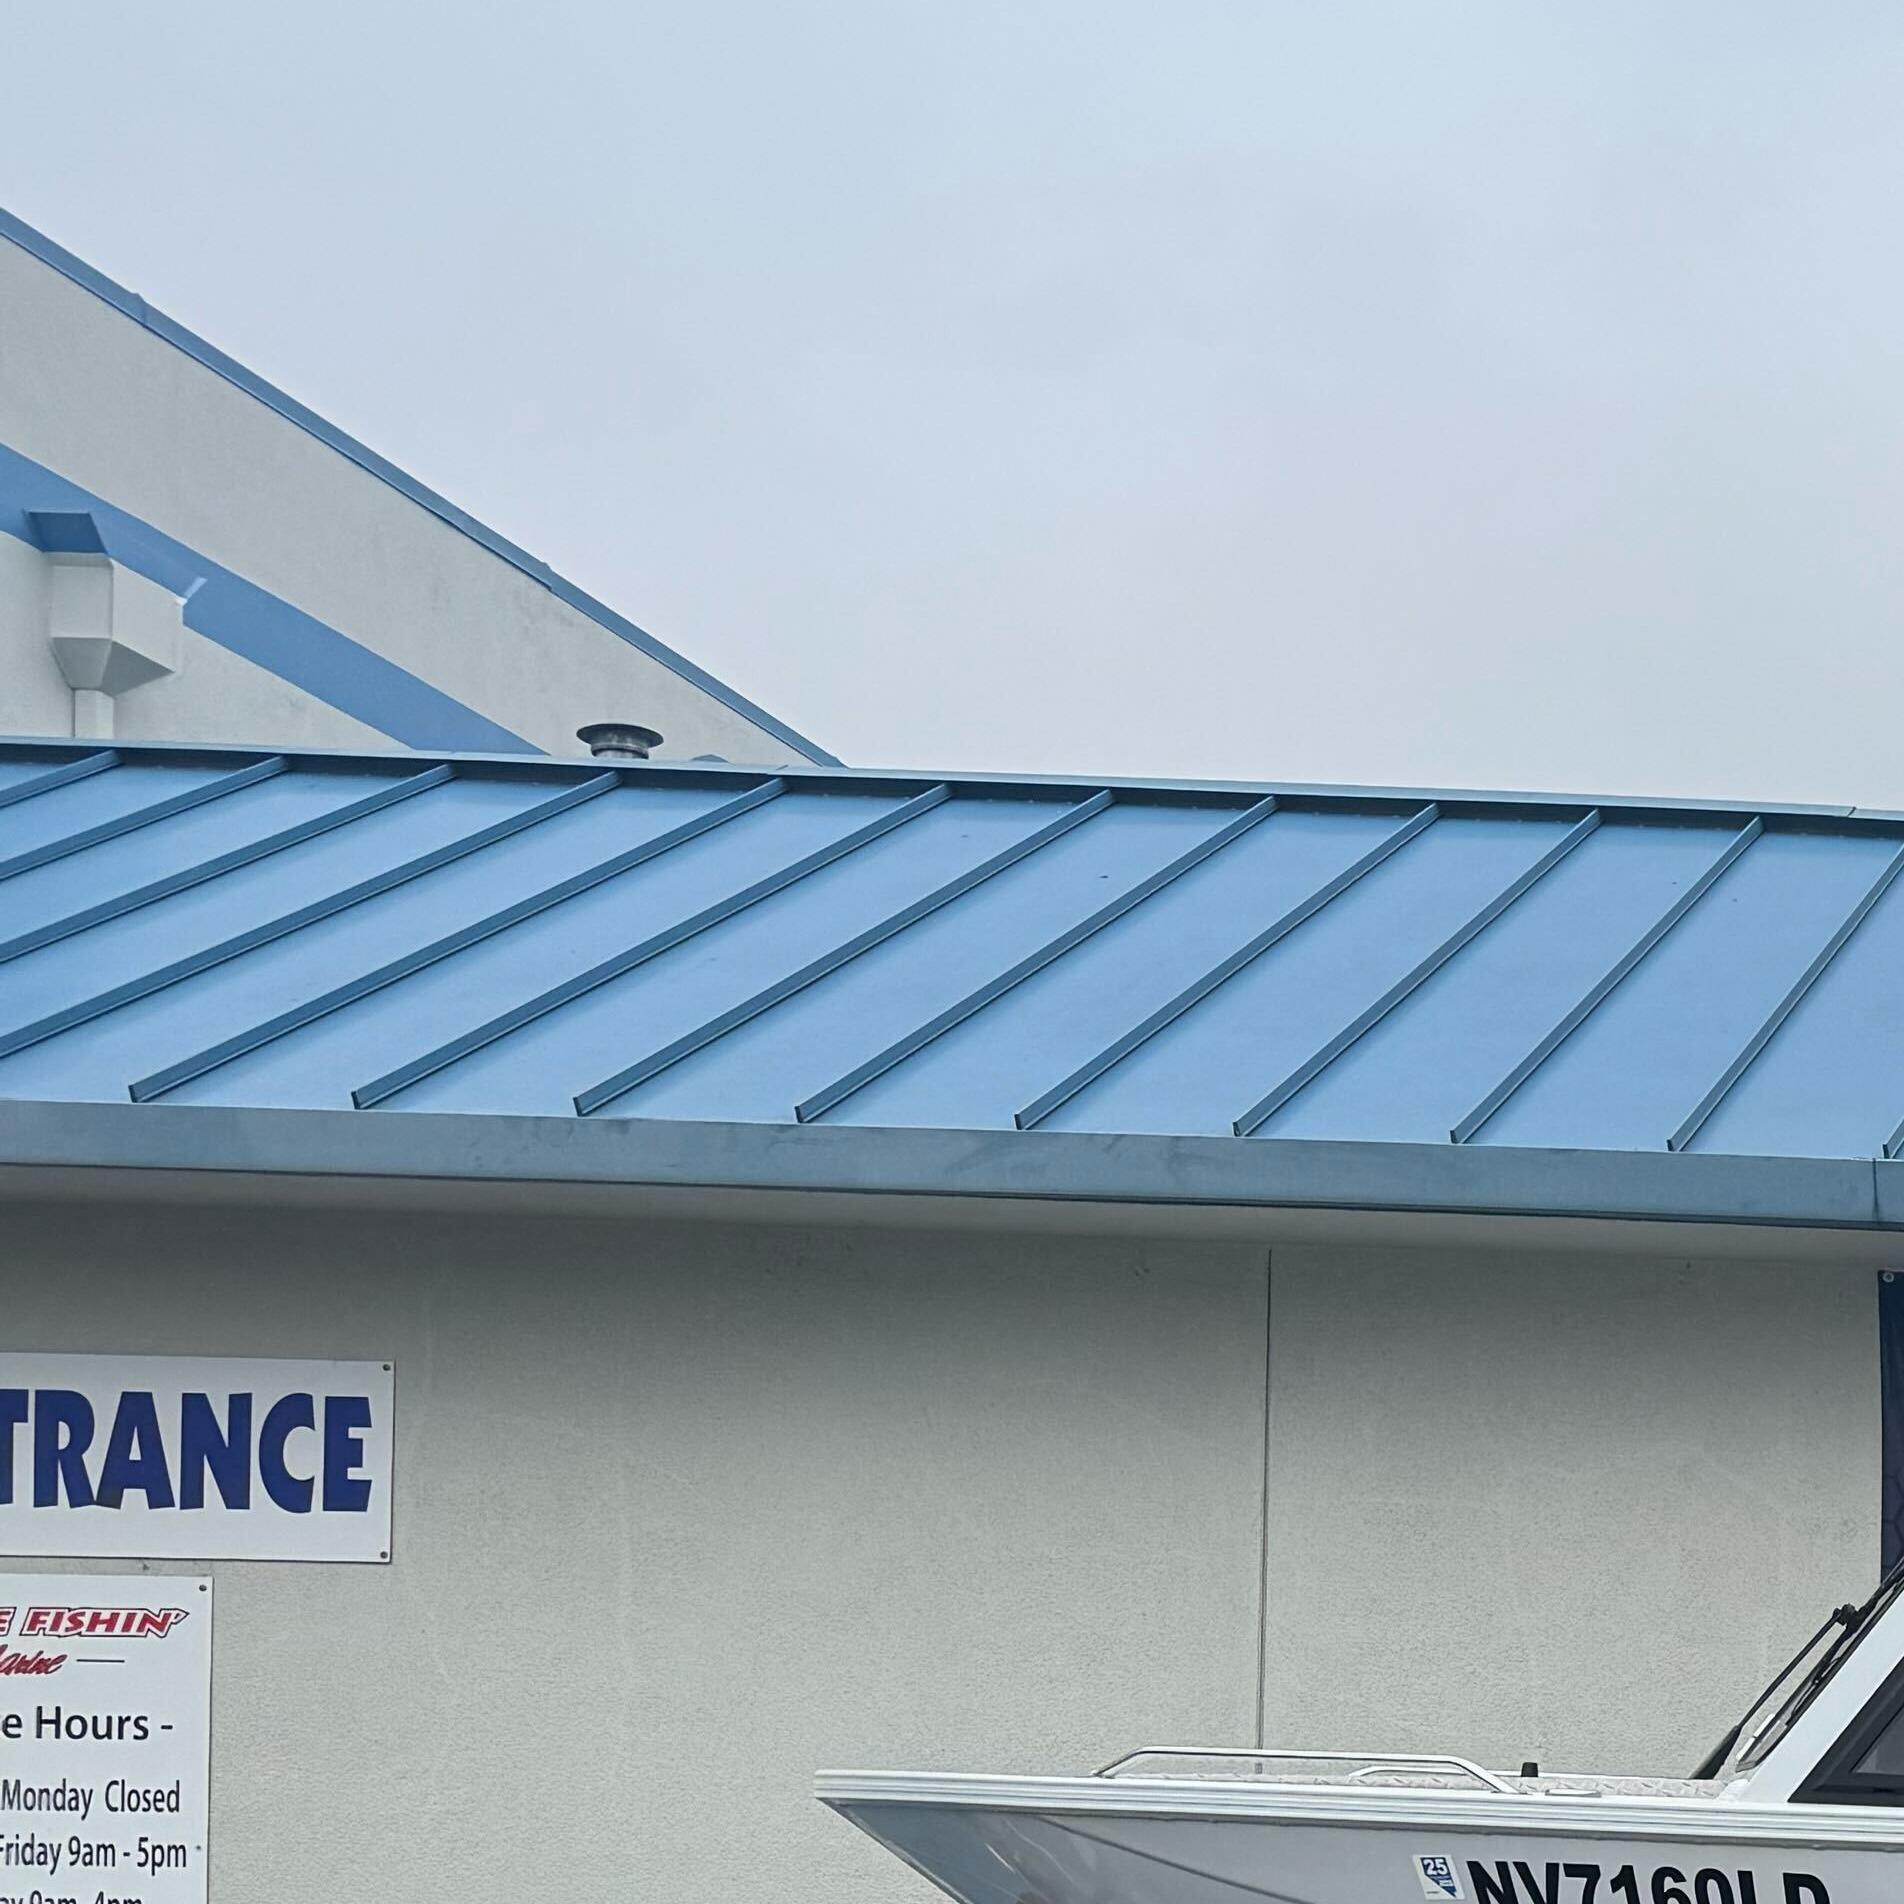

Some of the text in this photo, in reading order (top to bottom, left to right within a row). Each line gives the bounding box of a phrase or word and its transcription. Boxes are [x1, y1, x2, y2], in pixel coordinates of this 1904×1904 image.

[35, 1706, 149, 1740] Hours
[0, 1778, 180, 1821] Monday Closed
[69, 1835, 116, 1867] 9am
[137, 1837, 187, 1876] 5pm
[1423, 1859, 1448, 1875] 25
